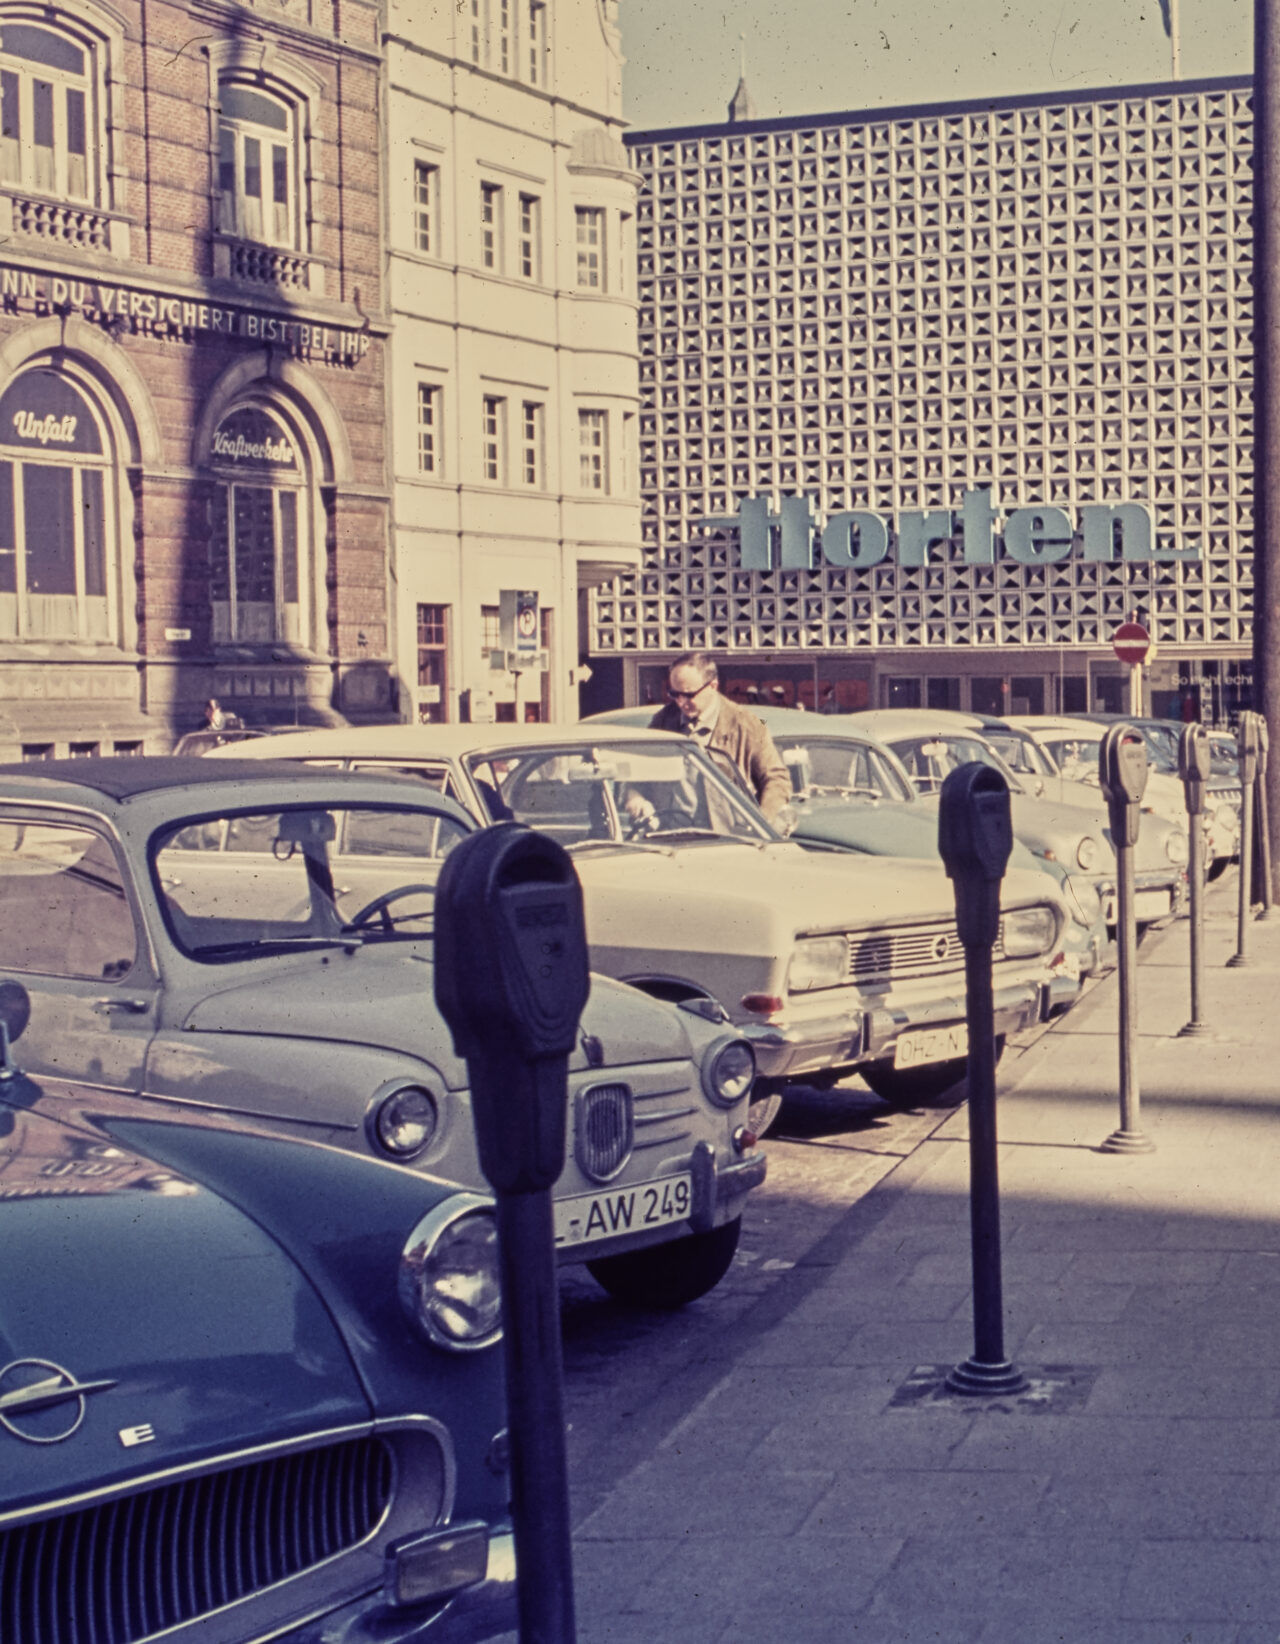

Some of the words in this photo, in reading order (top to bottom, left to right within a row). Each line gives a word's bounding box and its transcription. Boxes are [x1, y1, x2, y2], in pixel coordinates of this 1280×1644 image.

[52, 278, 85, 306] DU
[98, 286, 236, 333] VERSICHERT
[248, 315, 288, 342] BIST
[340, 331, 370, 356] IHR
[12, 409, 77, 443] Unfall
[210, 431, 293, 463] Kraftverkehr
[701, 488, 1199, 571] Horten
[643, 1180, 690, 1223] 249
